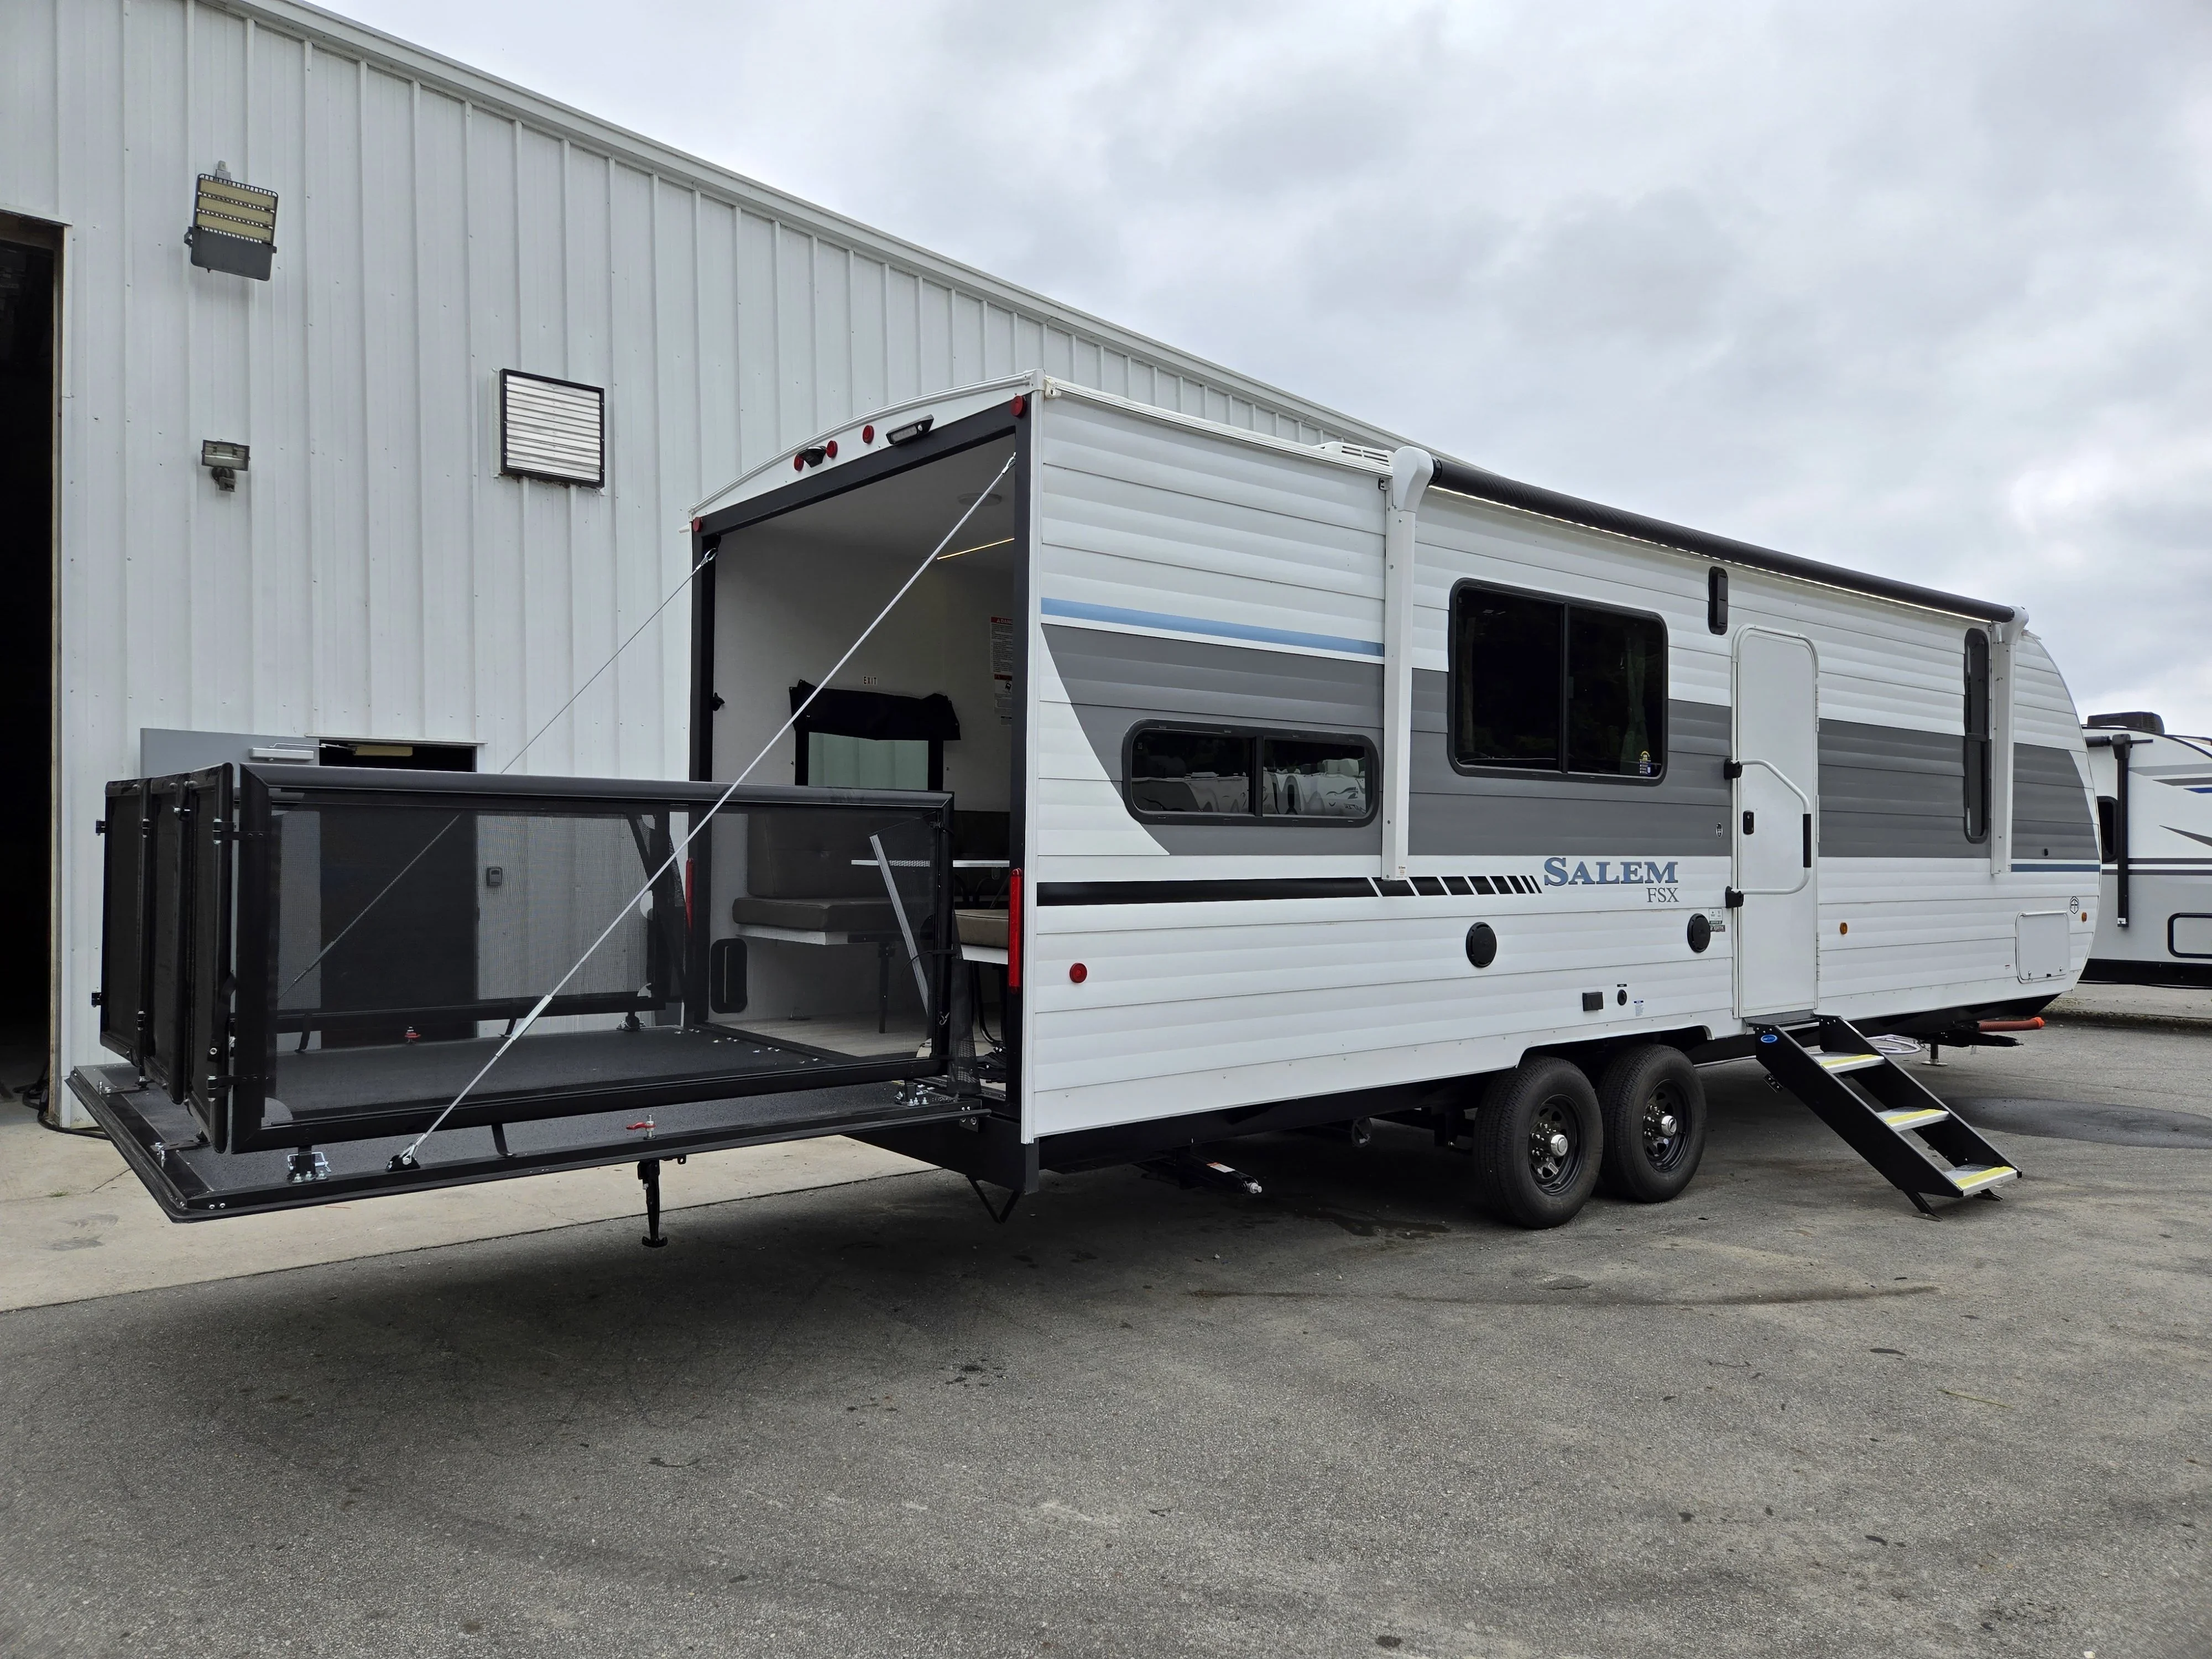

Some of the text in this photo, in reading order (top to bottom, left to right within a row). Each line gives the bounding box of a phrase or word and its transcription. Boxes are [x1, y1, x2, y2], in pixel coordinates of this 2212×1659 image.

[864, 676, 877, 685] EXIT
[1544, 857, 1678, 886] SALEM
[1646, 887, 1679, 902] FSX
